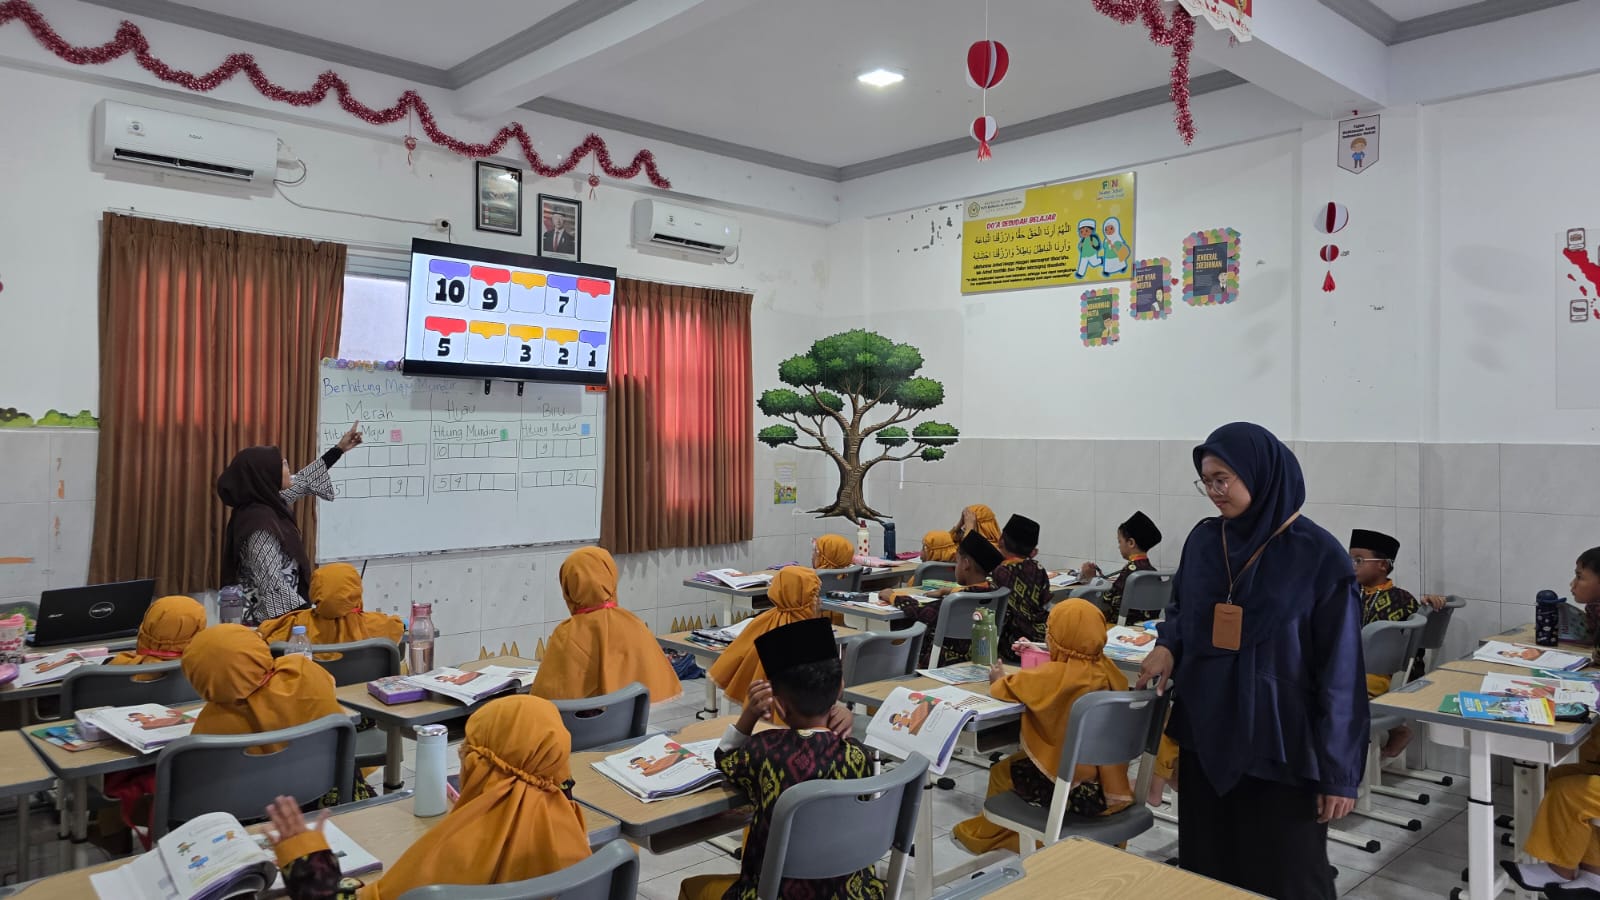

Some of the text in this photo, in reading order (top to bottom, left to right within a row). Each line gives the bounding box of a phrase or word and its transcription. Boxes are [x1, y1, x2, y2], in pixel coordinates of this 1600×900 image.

[1029, 213, 1057, 224] BELAJAR
[435, 278, 569, 313] 10 9 7
[437, 338, 596, 367] 5 3 2 1
[323, 377, 381, 395] Berhitung
[345, 400, 394, 420] Merah
[542, 402, 567, 417] Biru
[361, 425, 385, 441] Maju
[433, 424, 498, 440] Hitung Mundur
[436, 446, 447, 457] 10
[437, 477, 448, 488] 5
[567, 472, 574, 481] 2
[335, 483, 344, 495] 5
